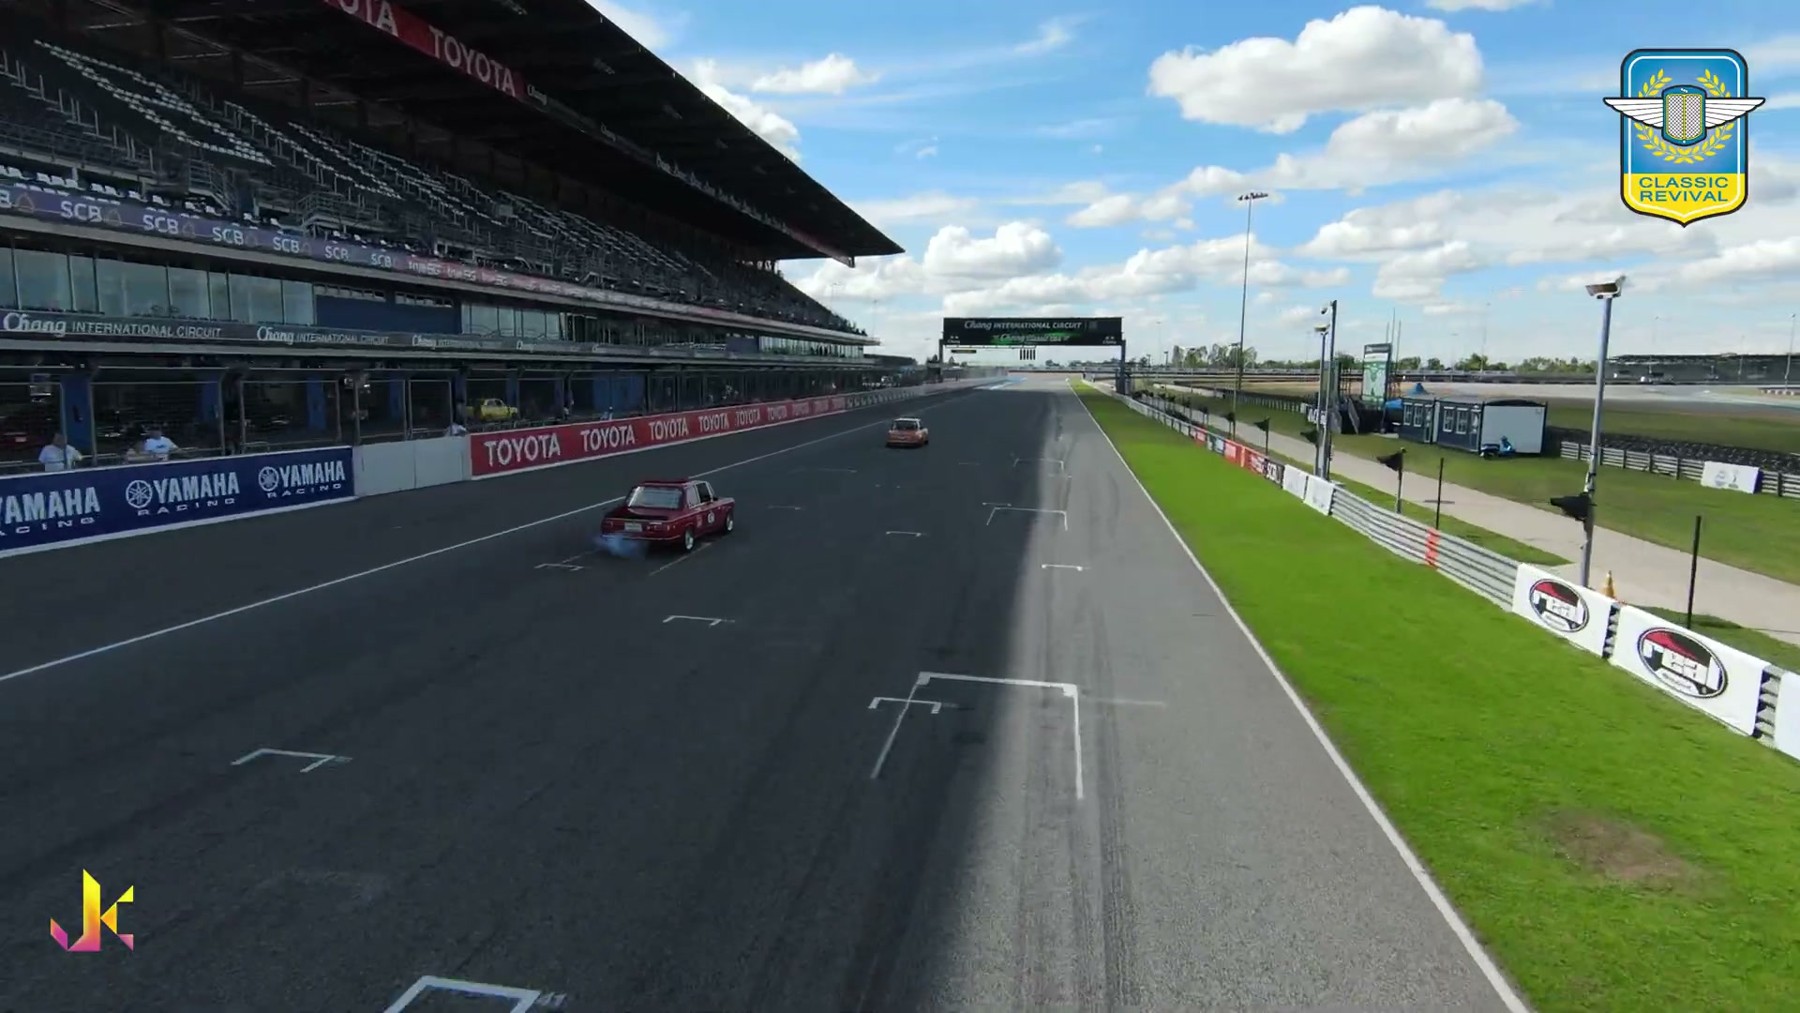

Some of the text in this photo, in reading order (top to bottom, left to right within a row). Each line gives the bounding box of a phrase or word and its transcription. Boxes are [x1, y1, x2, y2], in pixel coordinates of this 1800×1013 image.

[429, 25, 516, 97] TOYOTA
[60, 201, 102, 223] SCB
[143, 215, 179, 235] SCB
[212, 227, 244, 246] SCB
[273, 237, 300, 253] SCB
[3, 312, 222, 338] Chang INTERNATIONAL CIRCUIT
[257, 326, 295, 345] Chang
[964, 320, 992, 331] Chang
[699, 412, 730, 433] TOYOTA
[736, 408, 761, 426] TOYOTA
[579, 424, 636, 452] TOYOTA
[649, 416, 689, 441] TOYOTA
[484, 432, 561, 467] TOYOTA
[279, 460, 346, 488] YAMAHA
[153, 471, 240, 504] YAMAHA
[266, 483, 342, 499] RACING
[137, 498, 236, 516] RACING
